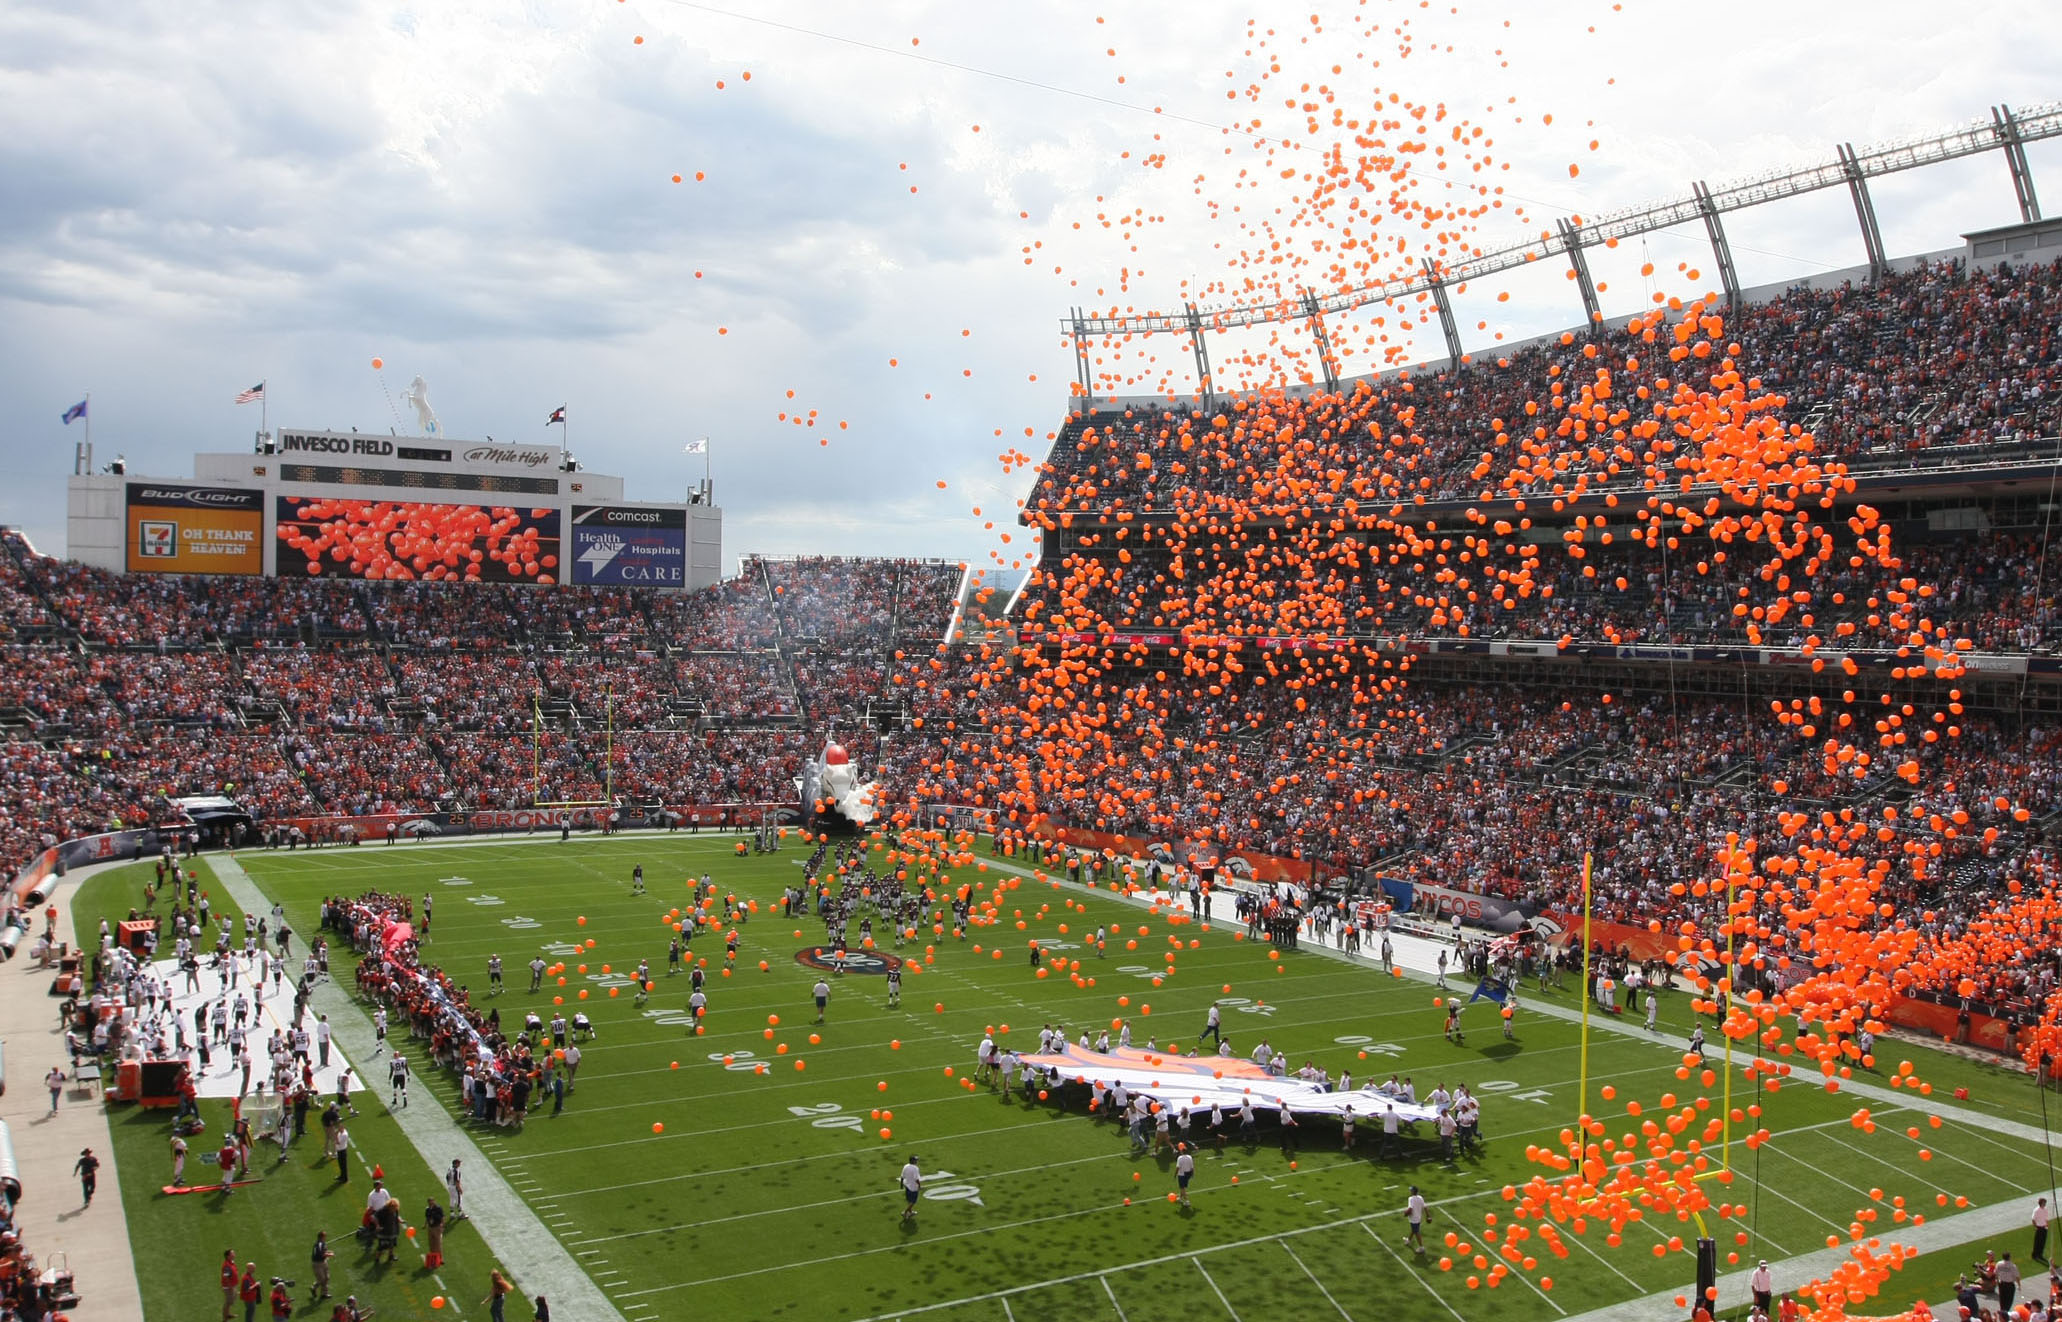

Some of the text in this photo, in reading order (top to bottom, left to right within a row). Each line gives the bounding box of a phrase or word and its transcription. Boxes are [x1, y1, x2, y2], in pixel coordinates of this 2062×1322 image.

[284, 435, 394, 456] INVESCO FIELD
[484, 449, 517, 463] Mile
[518, 451, 550, 468] High
[141, 490, 251, 503] BUD LIGHT
[607, 511, 660, 522] comcast
[183, 528, 253, 541] OH THANK
[580, 533, 620, 543] Health
[190, 543, 247, 555] HEAVEN!
[593, 542, 620, 552] ONE
[632, 545, 681, 556] Hospitals
[621, 566, 681, 581] CARE
[450, 813, 465, 825] 25
[475, 809, 606, 828] BRONCO
[630, 808, 644, 818] 25
[296, 1036, 307, 1044] 55
[707, 1051, 771, 1072] 30
[1478, 1081, 1554, 1102] 10
[787, 1103, 864, 1131] 20
[896, 1170, 982, 1204] 10
